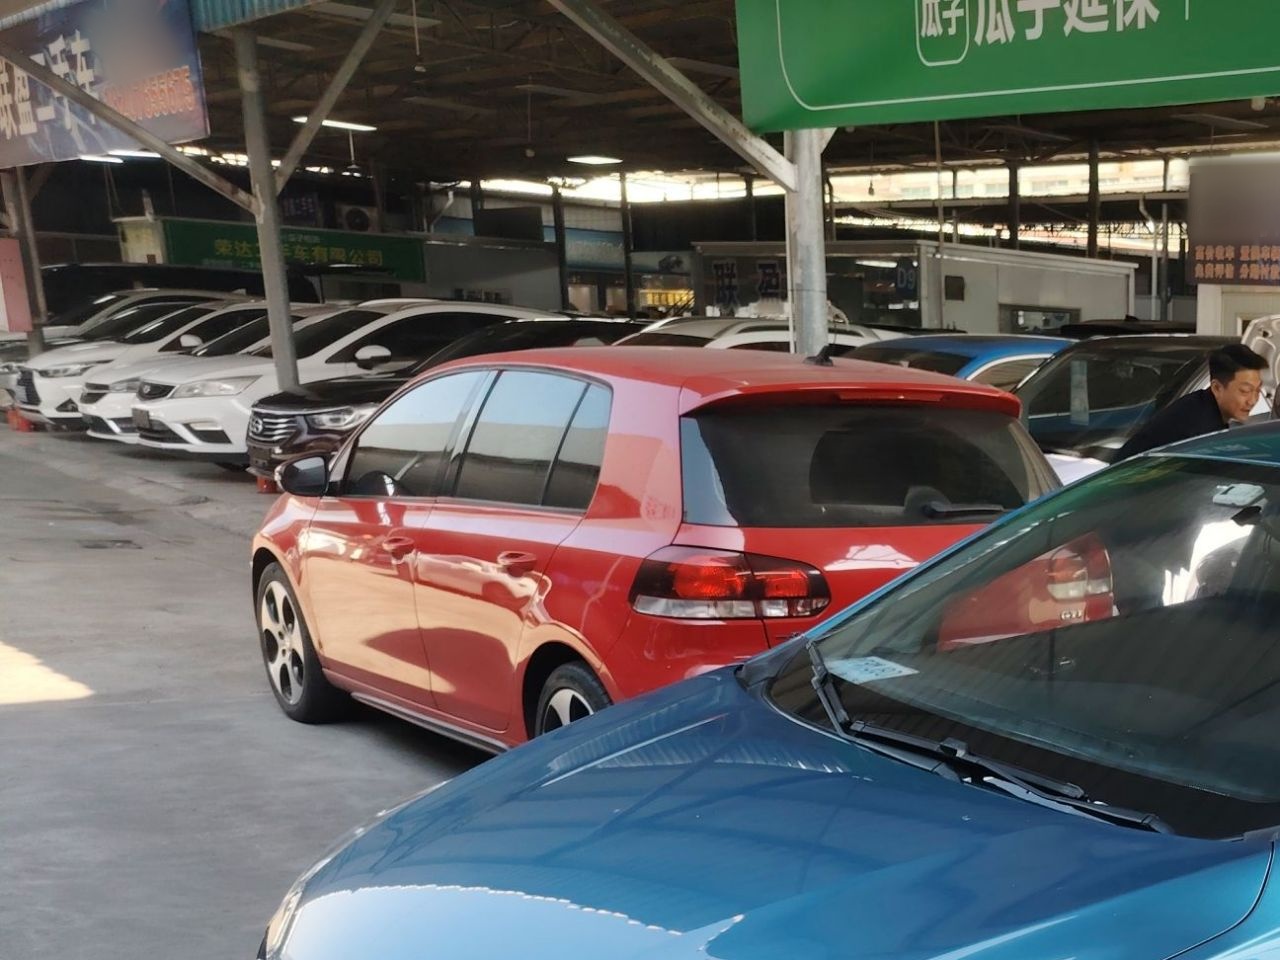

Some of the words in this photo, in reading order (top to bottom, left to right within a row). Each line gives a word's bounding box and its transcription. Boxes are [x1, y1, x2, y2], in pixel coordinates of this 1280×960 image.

[213, 238, 384, 267] 荣达手车有限公司
[897, 266, 916, 289] D9
